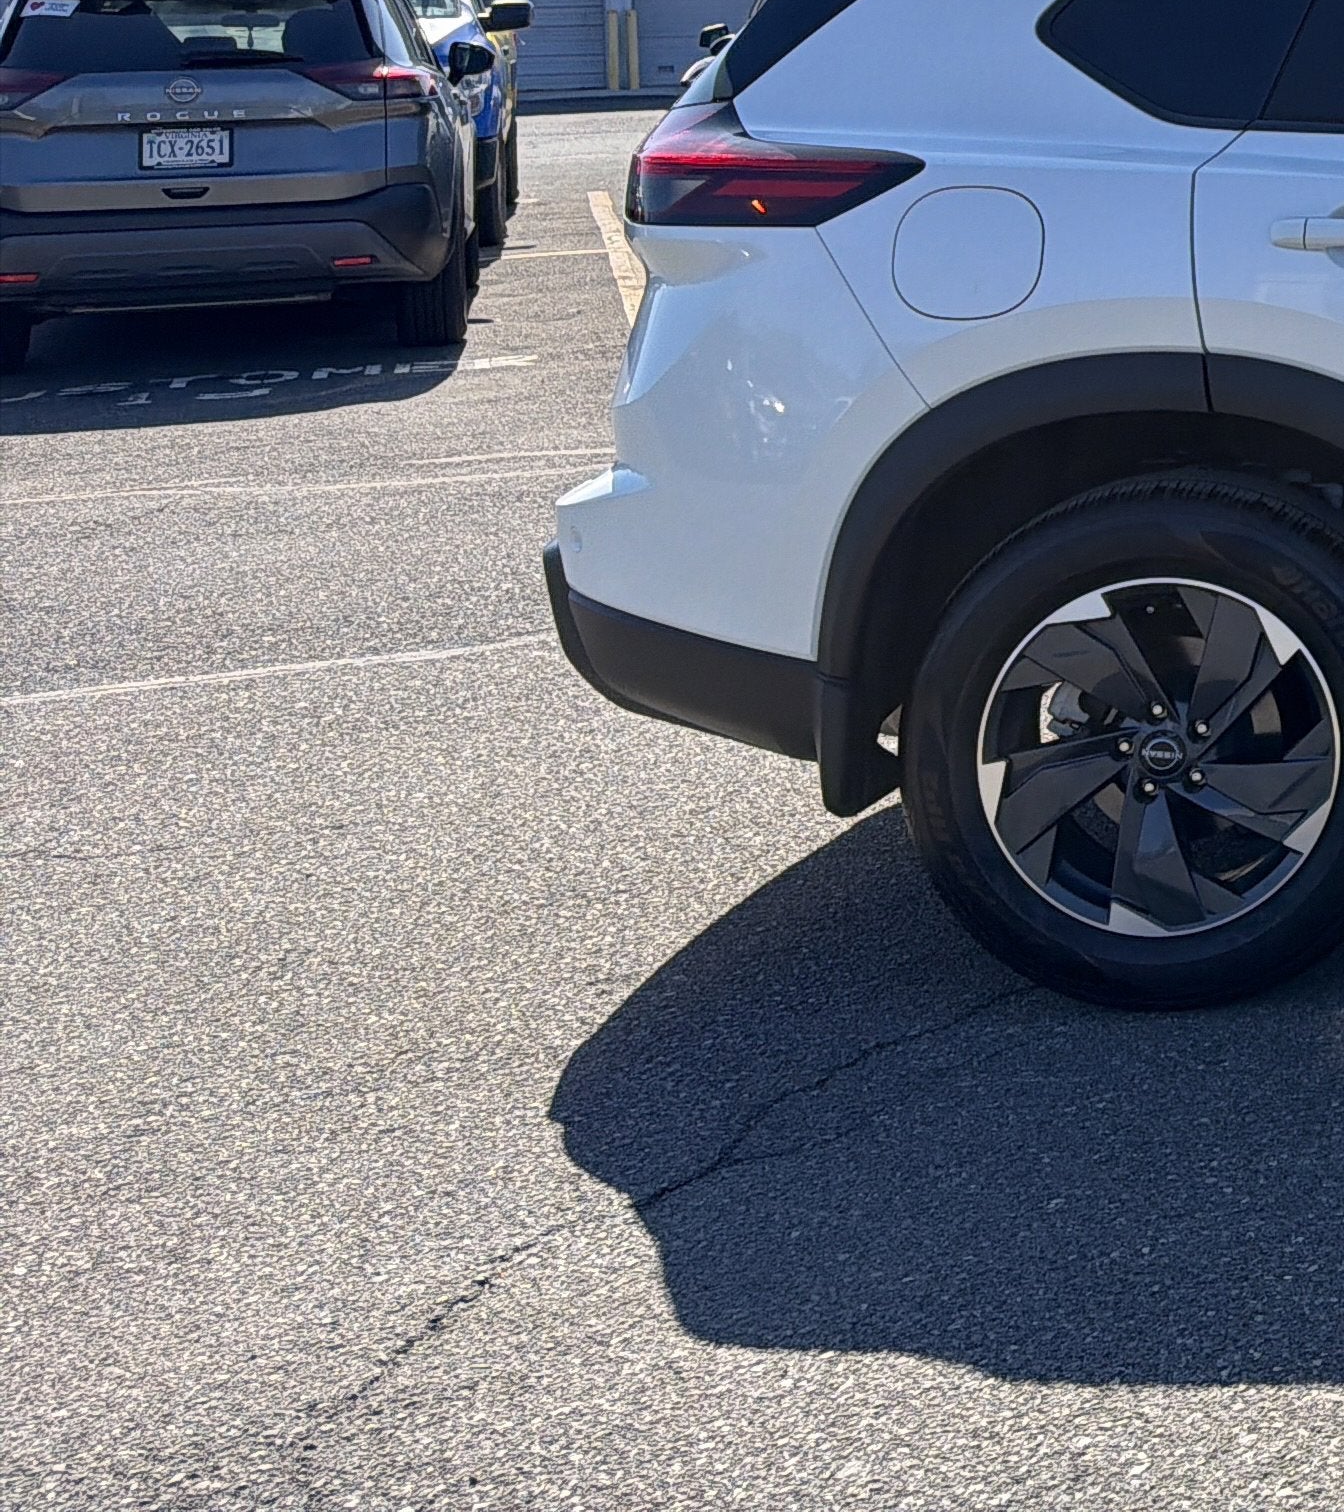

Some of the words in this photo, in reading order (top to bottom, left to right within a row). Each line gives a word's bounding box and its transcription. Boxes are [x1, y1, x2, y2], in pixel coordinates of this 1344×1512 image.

[117, 109, 246, 122] ROGUE
[146, 135, 225, 159] TCX-2651
[0, 354, 539, 403] STOMER
